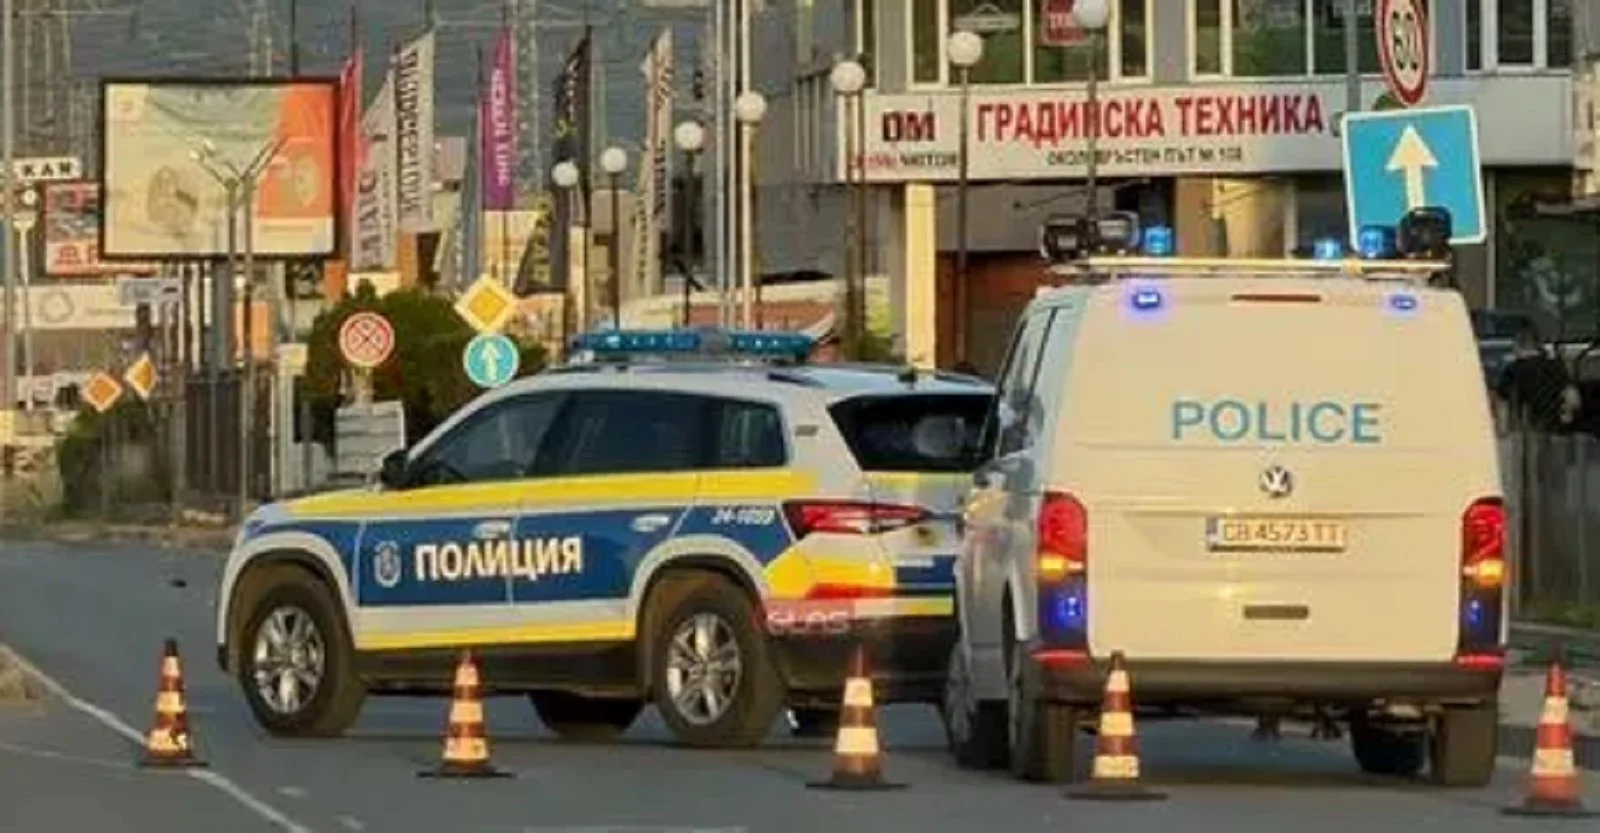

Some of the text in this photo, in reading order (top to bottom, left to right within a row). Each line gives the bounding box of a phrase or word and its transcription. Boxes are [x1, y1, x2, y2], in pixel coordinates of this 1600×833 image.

[977, 93, 1324, 148] ГРАДИНСКА ТЕХНИКА
[1171, 400, 1382, 443] POLICE
[414, 536, 582, 583] ПОЛИЦИЯ
